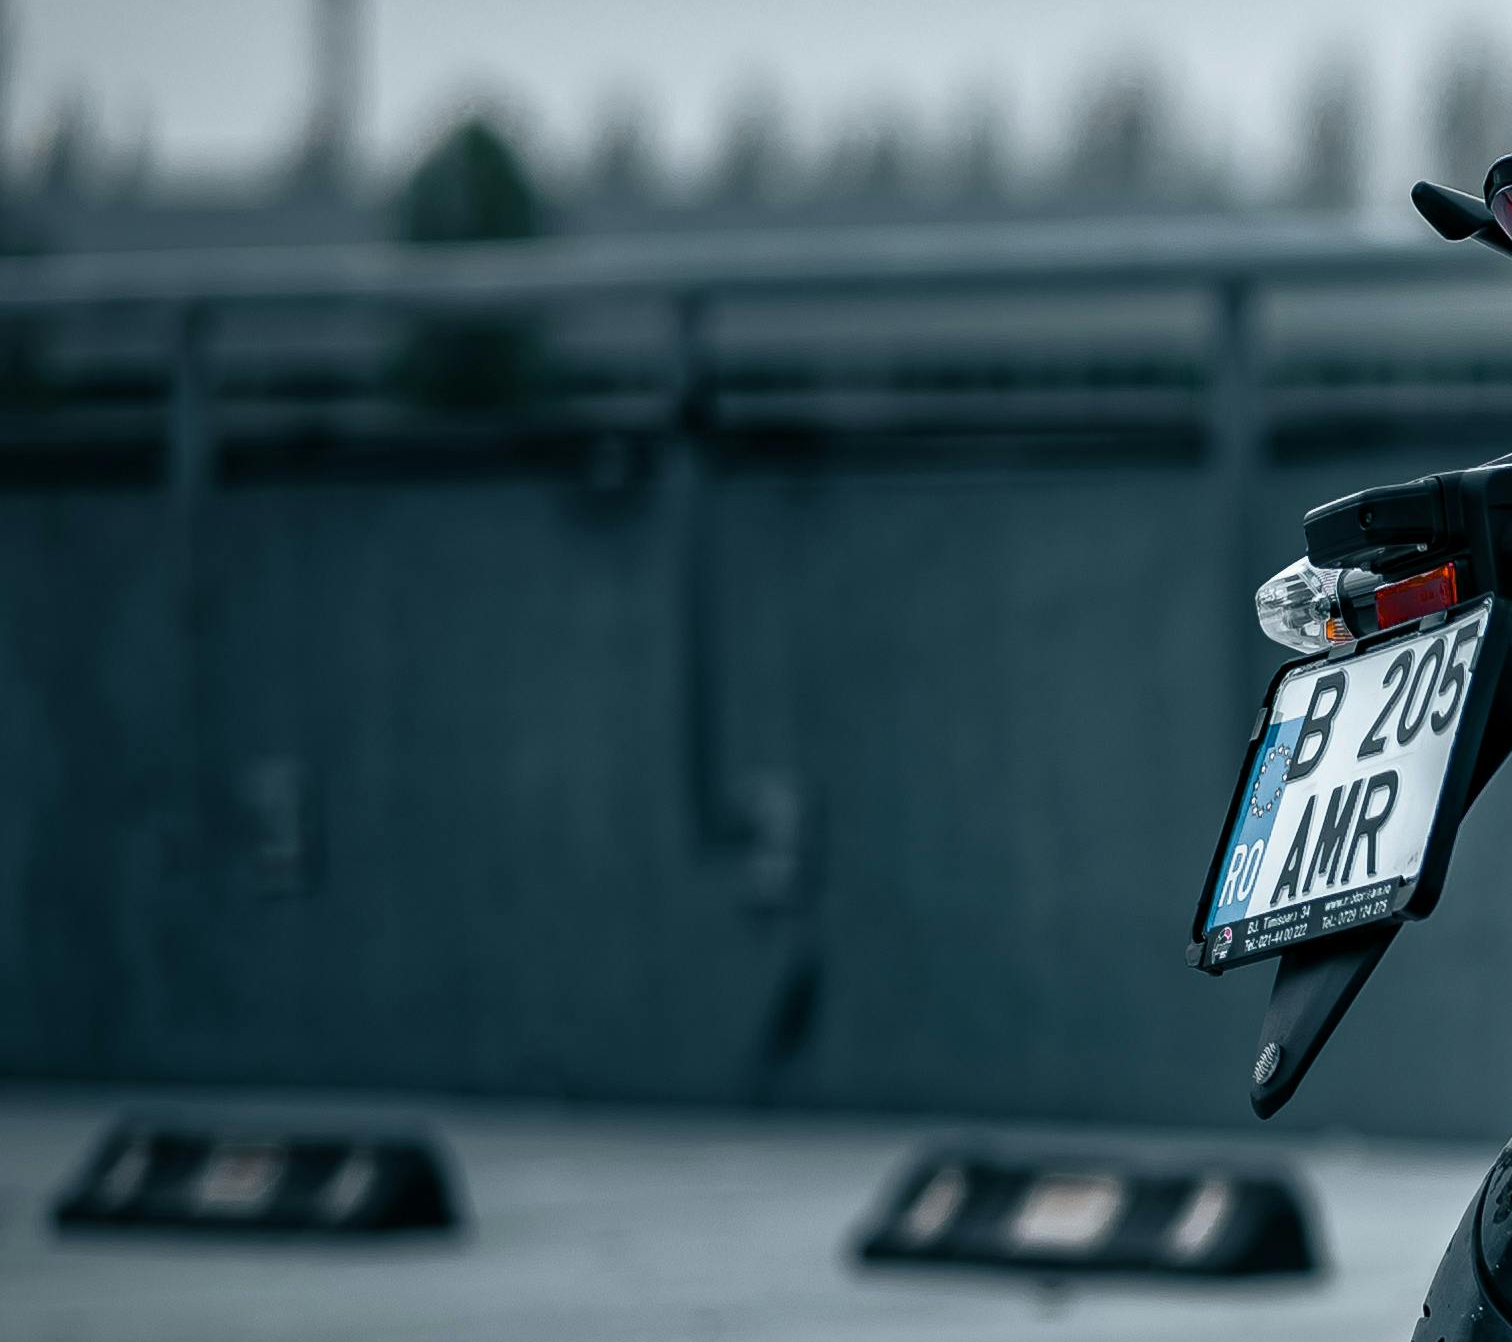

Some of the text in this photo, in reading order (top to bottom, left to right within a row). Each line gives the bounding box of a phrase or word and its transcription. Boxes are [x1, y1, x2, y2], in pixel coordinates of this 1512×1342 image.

[1287, 621, 1482, 782] B 205
[1219, 839, 1264, 907] RO
[1270, 769, 1399, 908] AMR
